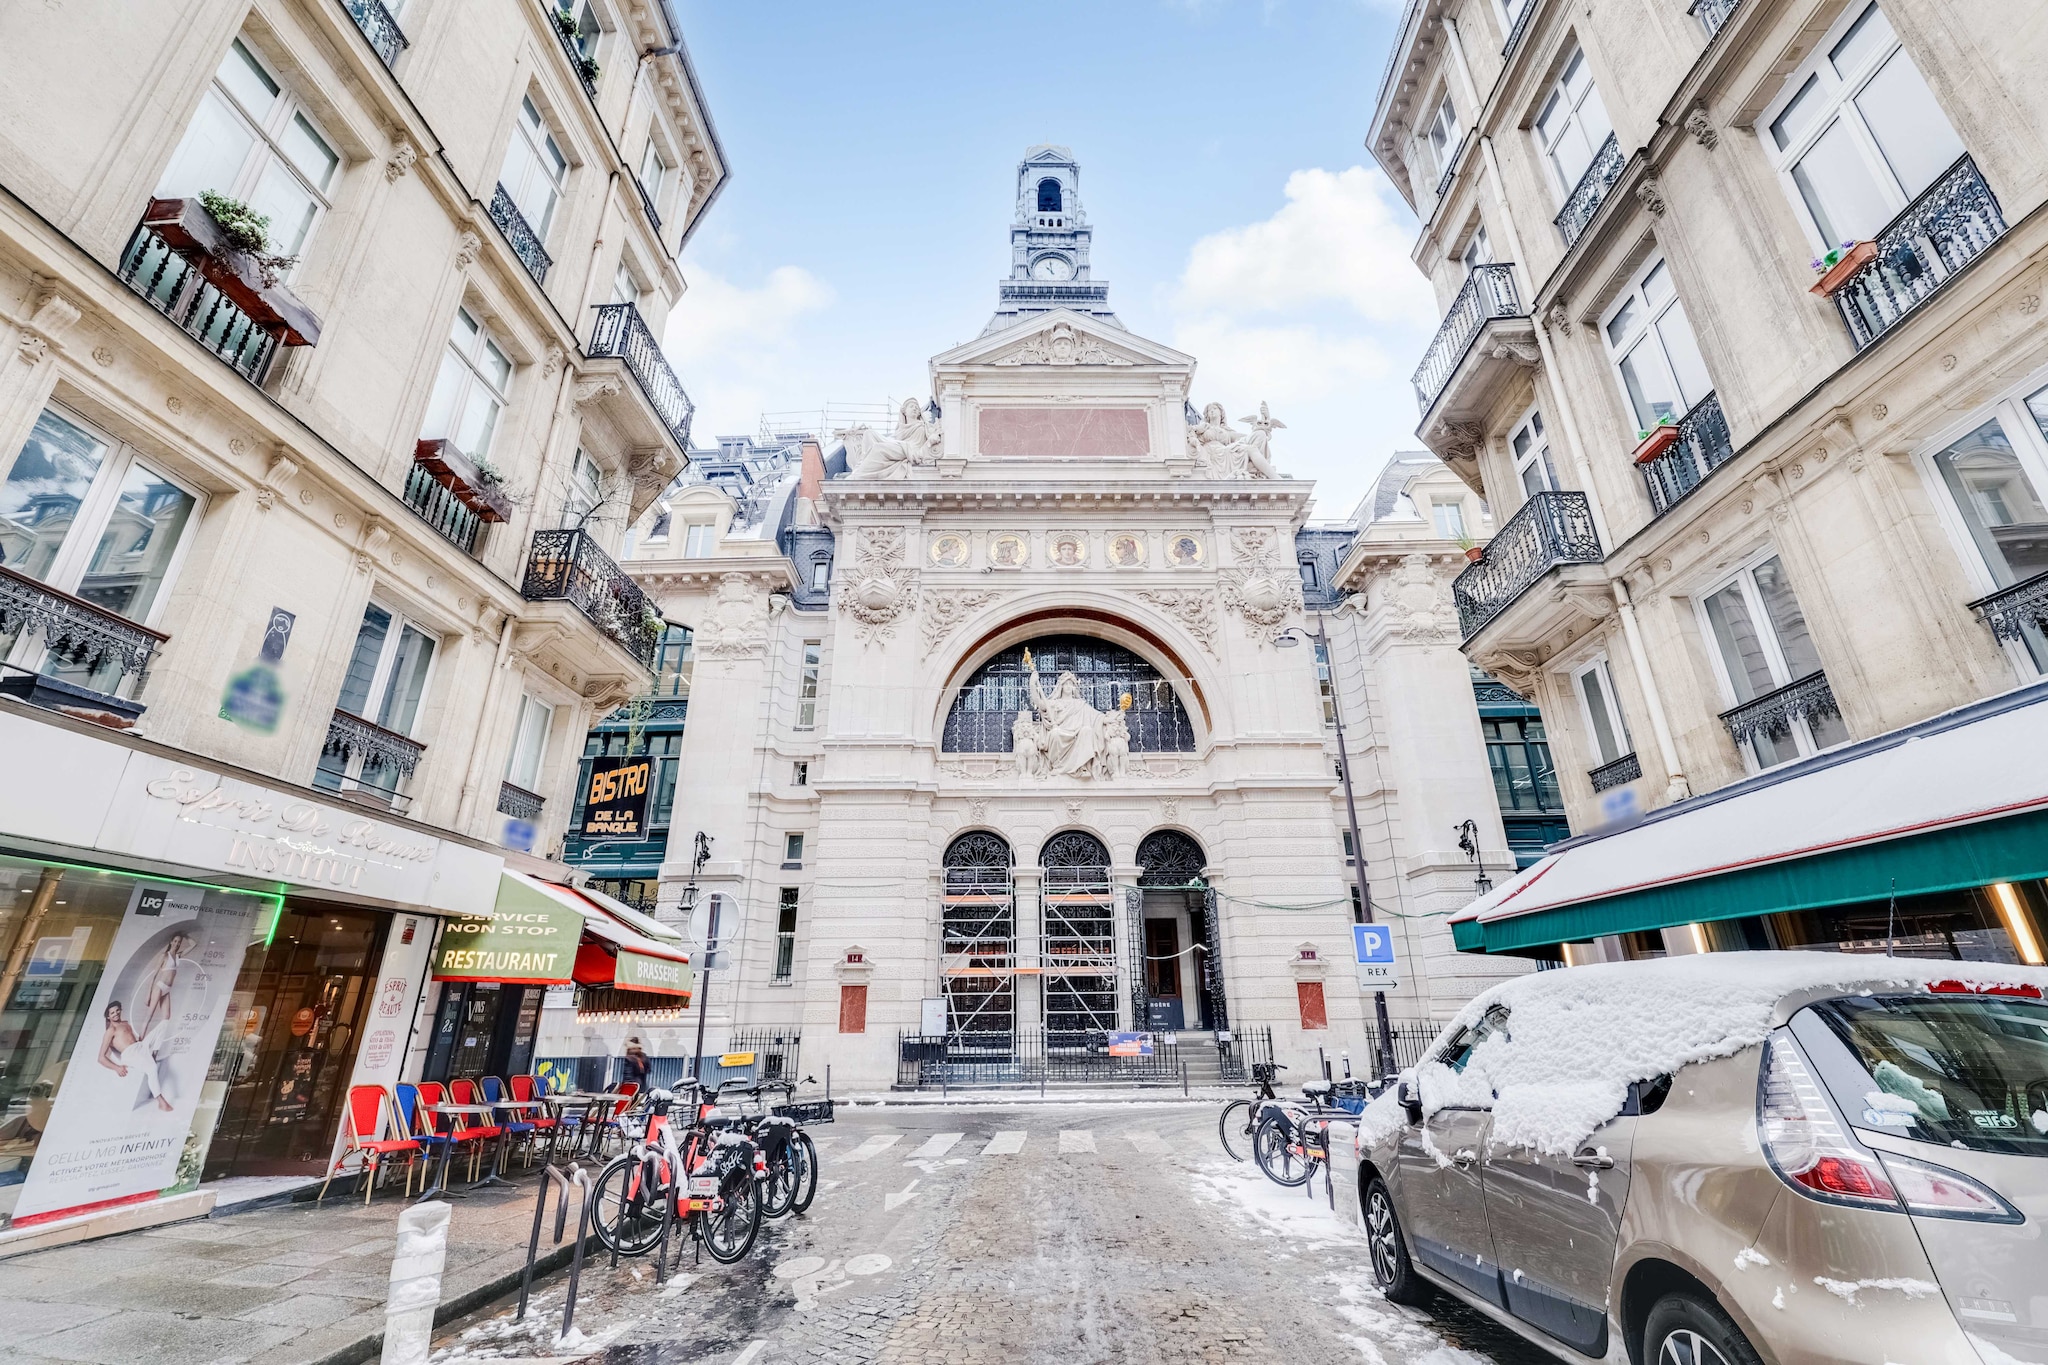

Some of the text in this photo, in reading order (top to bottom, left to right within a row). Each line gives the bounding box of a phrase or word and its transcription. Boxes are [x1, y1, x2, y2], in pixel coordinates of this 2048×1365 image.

[589, 763, 649, 805] BISTRO
[146, 769, 272, 818] Esprit
[277, 803, 332, 838] De
[594, 810, 634, 821] DE LA
[586, 821, 638, 835] BANQUE
[224, 837, 368, 889] INSTITUT
[141, 896, 162, 909] LPG
[168, 903, 188, 911] INNER
[215, 908, 237, 916] BETTER
[461, 912, 549, 923] SERVICE
[446, 923, 558, 936] NON STOP
[1363, 931, 1382, 957] P
[442, 950, 558, 972] RESTAURANT
[637, 960, 679, 983] BRASSERIE
[1367, 968, 1388, 976] REX
[385, 980, 407, 993] ESPRIT
[1974, 1114, 2001, 1127] elf
[48, 1137, 174, 1166] CELLU M6 INFINITY
[49, 1165, 83, 1177] ACTIVEZ
[85, 1161, 108, 1171] VOTRE
